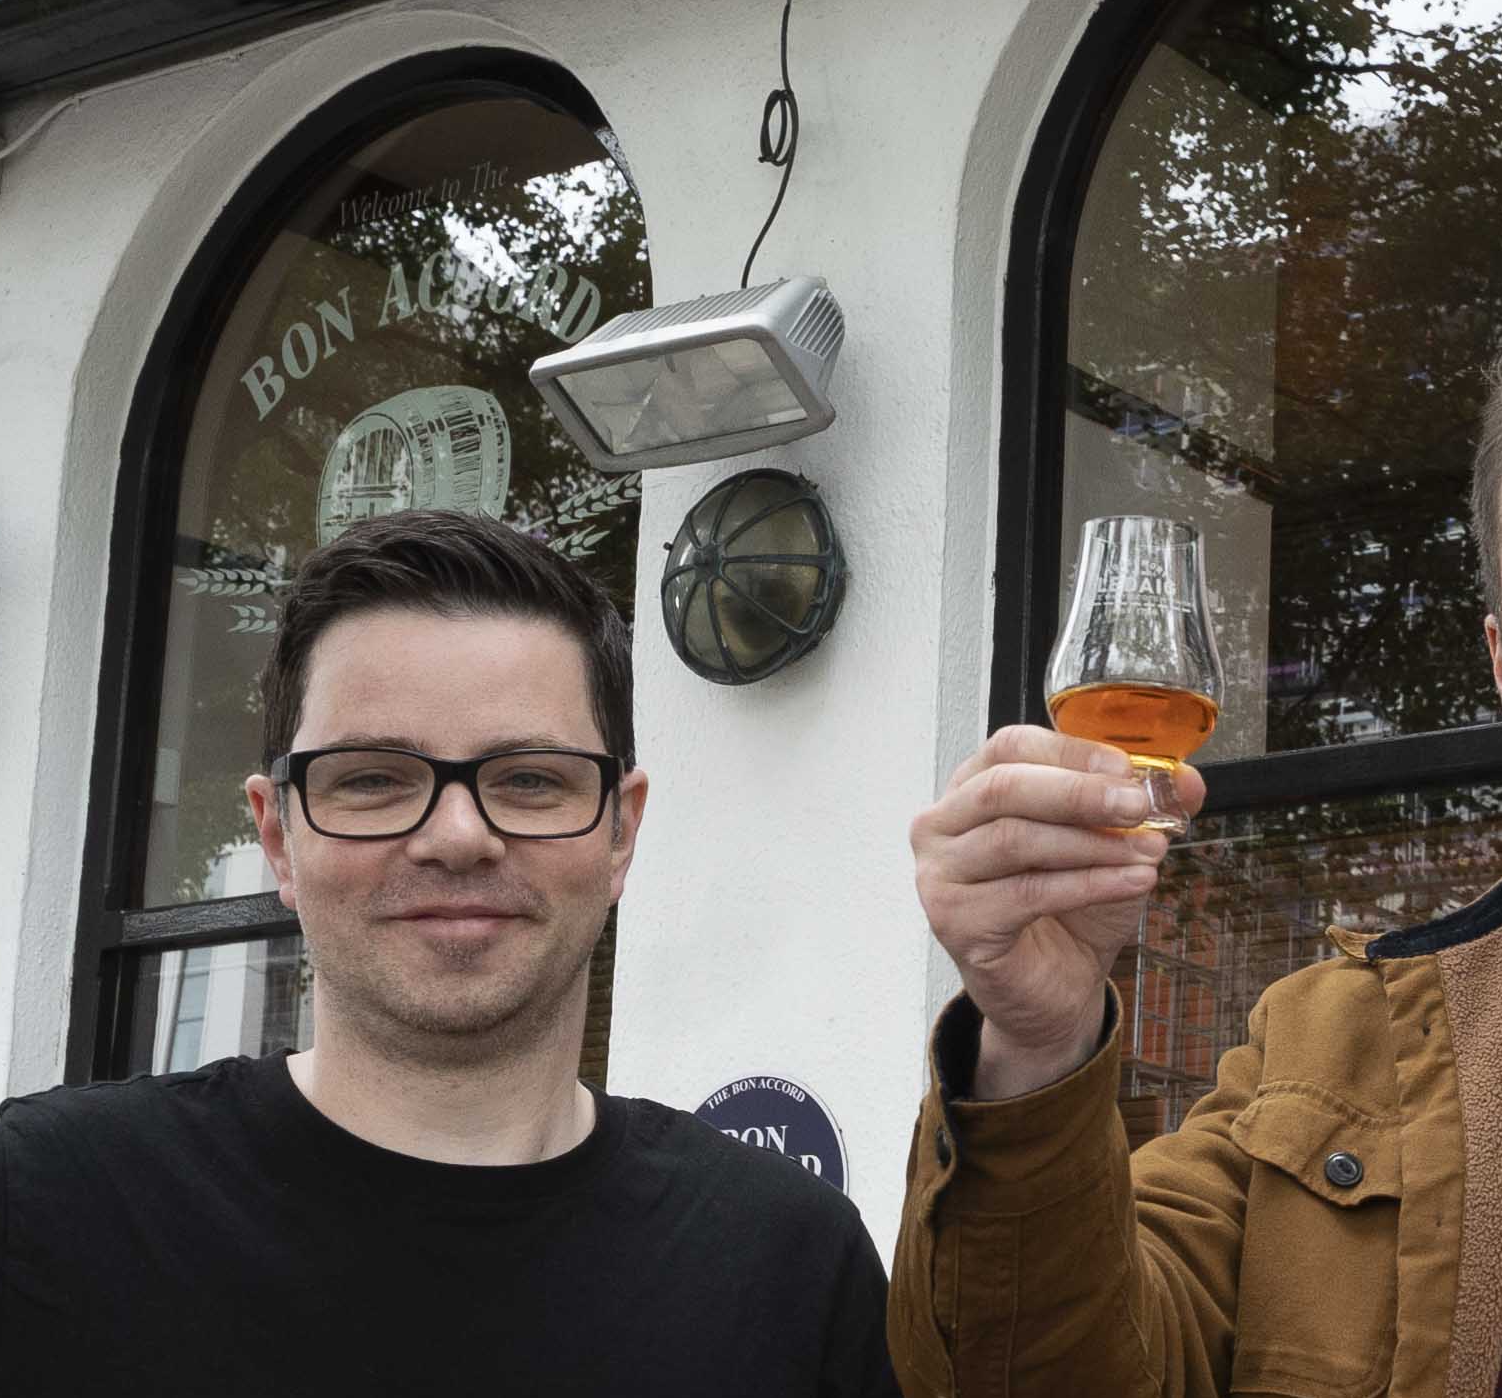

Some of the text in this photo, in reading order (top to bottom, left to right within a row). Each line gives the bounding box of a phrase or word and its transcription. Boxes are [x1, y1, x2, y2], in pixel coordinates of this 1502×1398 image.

[339, 159, 509, 228] Welcome to The
[239, 285, 355, 422] BON
[705, 1077, 806, 1110] THE BON ACCORD
